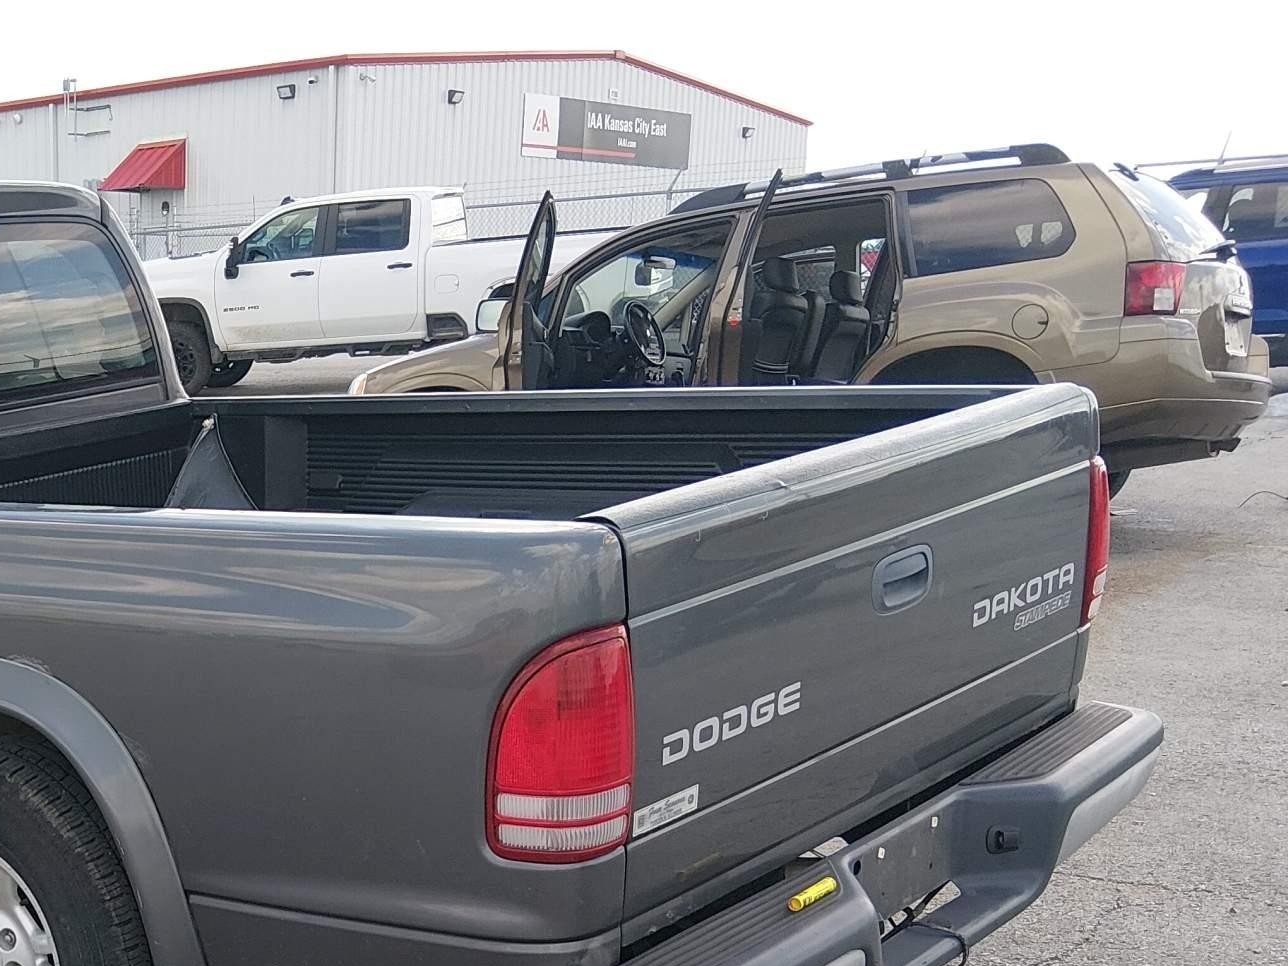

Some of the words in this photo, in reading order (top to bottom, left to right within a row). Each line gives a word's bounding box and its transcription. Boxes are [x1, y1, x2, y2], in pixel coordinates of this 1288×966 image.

[587, 112, 603, 129] IAA
[604, 113, 633, 133] Kansas
[634, 117, 650, 138] City
[651, 120, 667, 136] East
[972, 562, 1075, 628] DAKOTA
[662, 681, 801, 767] DODGE
